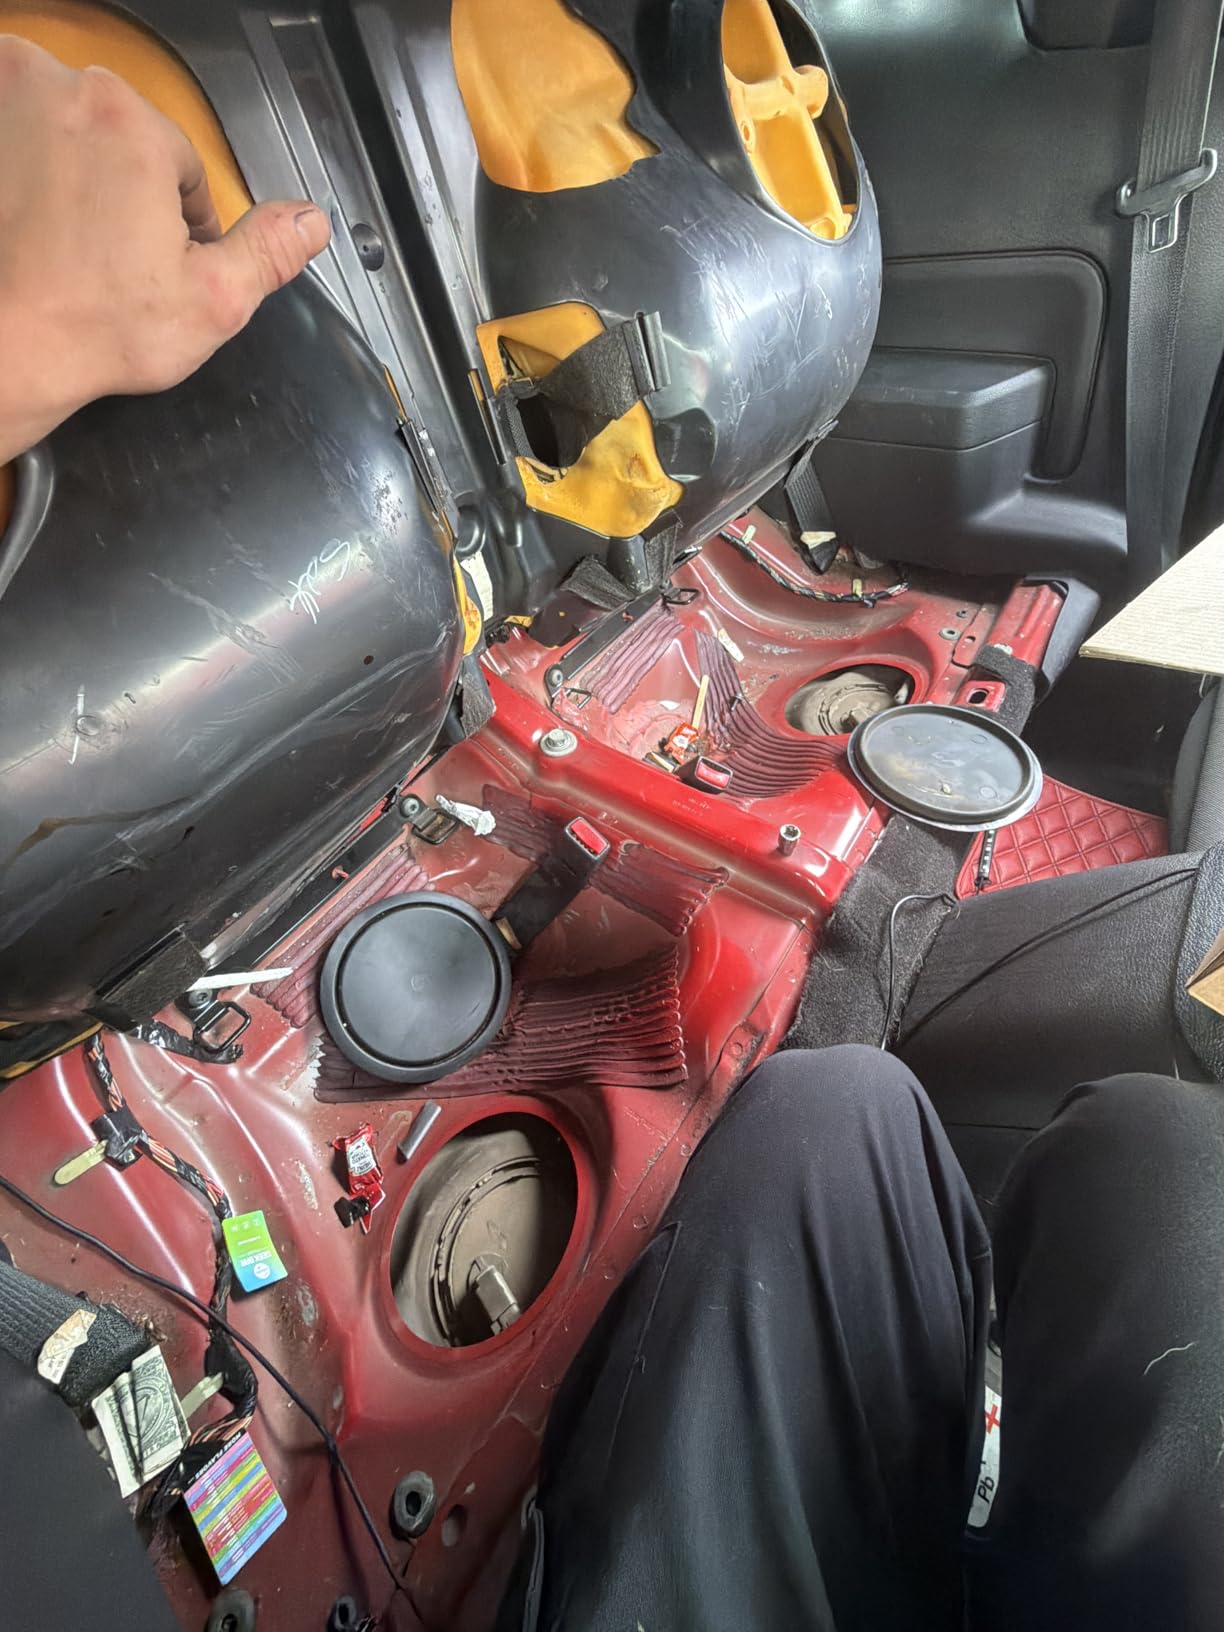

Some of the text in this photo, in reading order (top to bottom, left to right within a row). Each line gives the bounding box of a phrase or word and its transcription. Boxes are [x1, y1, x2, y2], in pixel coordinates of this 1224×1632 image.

[194, 1431, 242, 1480] MORE FLAVORS
[977, 1476, 995, 1504] Pb
